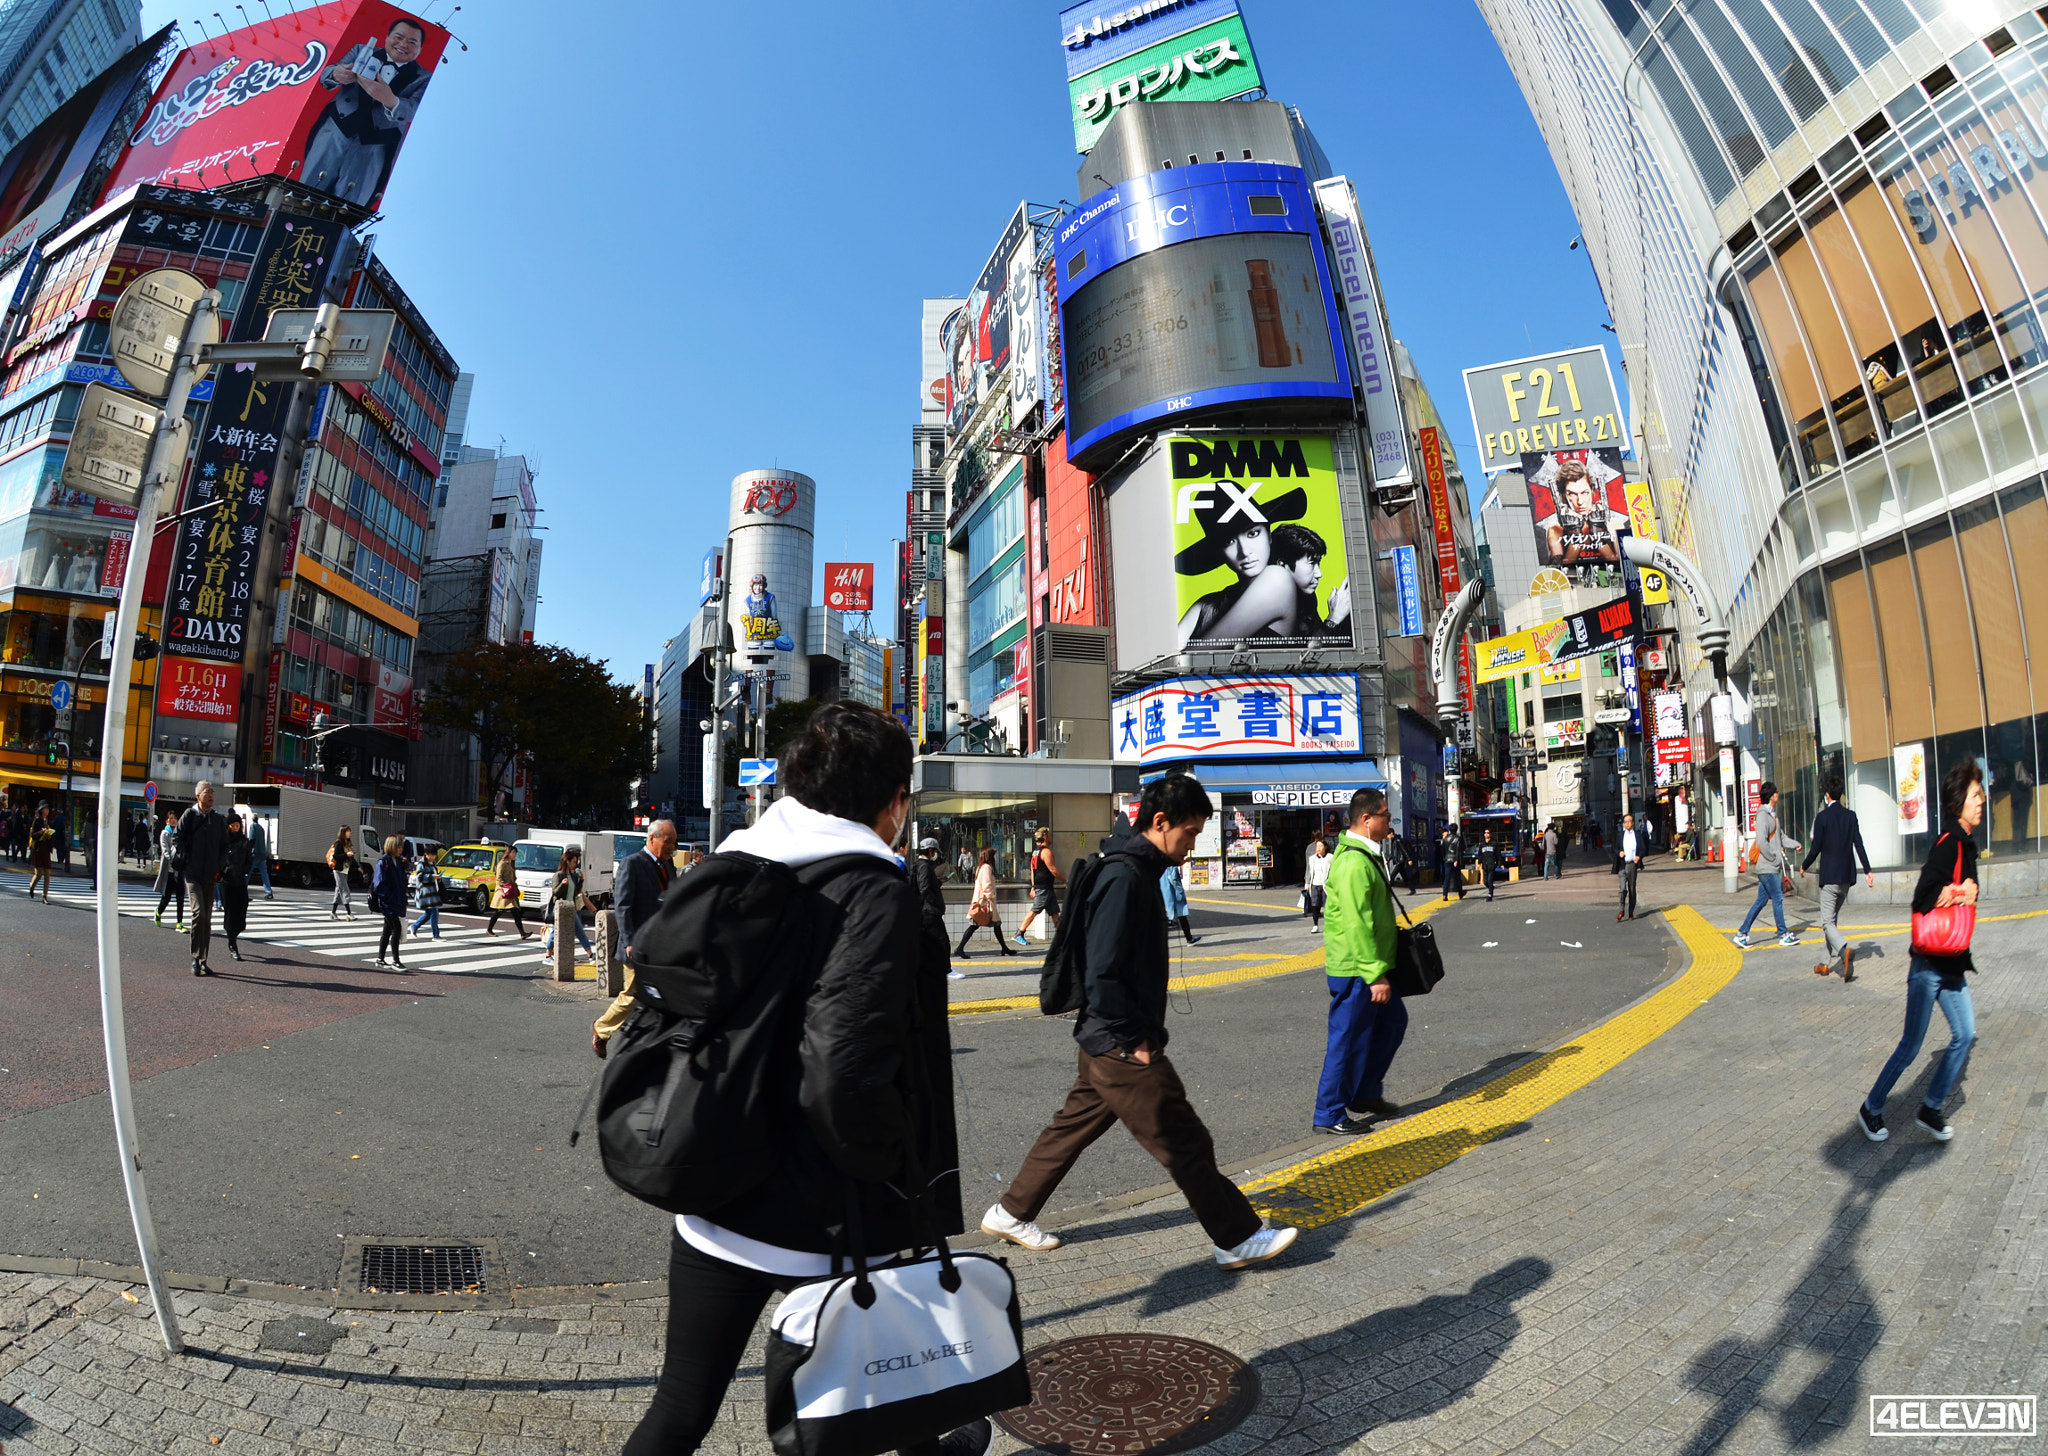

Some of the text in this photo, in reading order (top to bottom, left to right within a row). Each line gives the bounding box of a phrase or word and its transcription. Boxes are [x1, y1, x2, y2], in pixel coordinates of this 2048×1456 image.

[1077, 37, 1240, 119] サロンパス
[137, 214, 203, 242] 月の宴
[1061, 193, 1121, 243] DHC Channel
[1127, 203, 1190, 242] DHC
[400, 297, 410, 311] 9F
[1331, 213, 1384, 394] Taisei neon
[71, 365, 105, 379] AEON
[1167, 396, 1193, 412] DHC
[1501, 362, 1582, 422] F21
[208, 425, 279, 453] 大新年会
[390, 420, 414, 452] ガスト
[1376, 430, 1396, 442] (03)
[1376, 442, 1399, 453] 3719
[1484, 413, 1619, 460] FOREVER 21
[221, 446, 256, 463] 2017
[1170, 440, 1310, 480] DMM
[1378, 452, 1402, 463] 2468
[752, 479, 797, 488] SHIBUYA
[1423, 432, 1448, 532] クスリのことなら
[740, 485, 799, 517] 109
[1176, 482, 1269, 525] FX
[112, 531, 130, 540] SALE
[195, 461, 249, 620] 東京体育館
[834, 567, 865, 587] H&M
[1646, 577, 1661, 589] 4F
[1656, 552, 1706, 618] 渋谷センター街
[176, 597, 191, 612] 金
[845, 591, 862, 599] この先
[845, 598, 867, 606] 150m
[1400, 551, 1418, 631] 大盛堂商事ビル
[229, 603, 244, 618] 土
[1598, 600, 1633, 634] ALVARK
[171, 616, 242, 646] 2DAYS
[928, 631, 942, 640] JTB
[1434, 607, 1455, 680] 渋谷センター街
[169, 641, 240, 659] wagakkiband.jp
[175, 665, 227, 688] 11.6日
[1618, 643, 1640, 709] 服の青山
[178, 684, 220, 700] チケット
[381, 692, 404, 716] アコム
[1119, 690, 1343, 753] 大盛堂書店
[1458, 712, 1474, 743] 牛繁
[1301, 740, 1355, 749] BOOKS TAISEIDO
[371, 756, 406, 783] LUSH
[864, 1355, 919, 1377] CECIL
